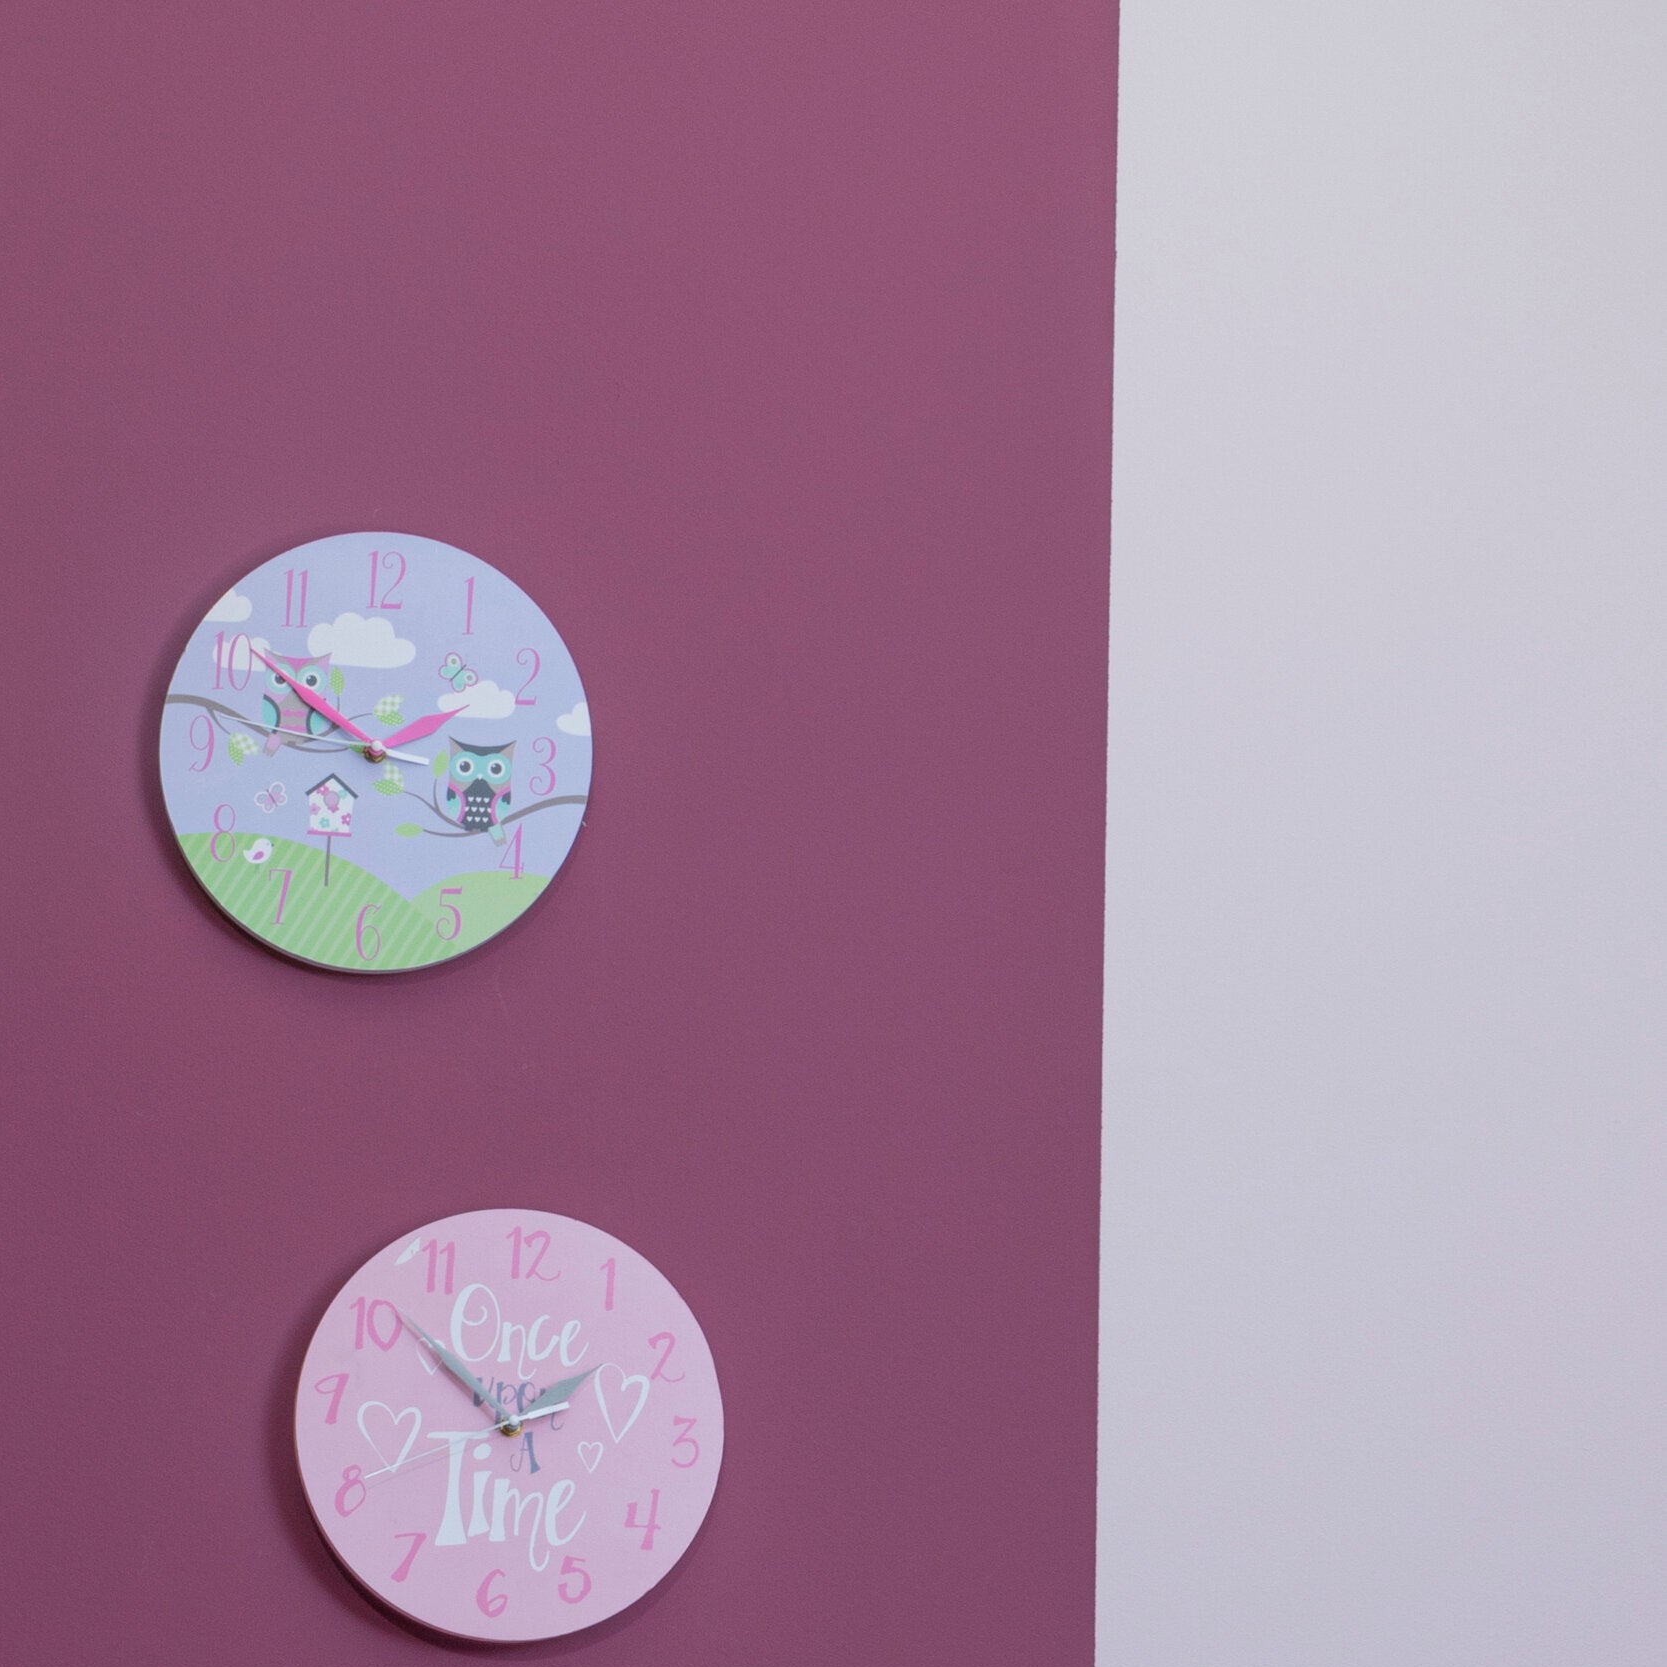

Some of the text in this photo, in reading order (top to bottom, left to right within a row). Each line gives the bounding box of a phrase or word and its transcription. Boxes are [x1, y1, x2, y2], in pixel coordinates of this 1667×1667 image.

[281, 569, 309, 628] 11
[366, 550, 407, 610] 12
[462, 576, 475, 636] 1
[211, 631, 252, 691] 10
[514, 647, 541, 706] 2
[189, 715, 215, 773] 9
[529, 737, 557, 796] 3
[209, 804, 236, 862] 8
[498, 823, 525, 880] 4
[267, 868, 292, 925] 7
[435, 886, 463, 940] 5
[355, 904, 381, 961] 6
[421, 1239, 455, 1295] 11
[506, 1226, 561, 1281] 12
[599, 1257, 616, 1311] 1
[349, 1296, 403, 1351] 10
[450, 1283, 589, 1380] Once
[648, 1332, 685, 1383] 2
[314, 1373, 349, 1424] 9
[510, 1431, 541, 1474] A
[670, 1416, 700, 1469] 3
[334, 1464, 367, 1518] 8
[427, 1431, 586, 1572] Time
[624, 1488, 661, 1551] 4
[390, 1533, 427, 1583] 7
[557, 1555, 592, 1604] 5
[476, 1568, 508, 1618] 6
